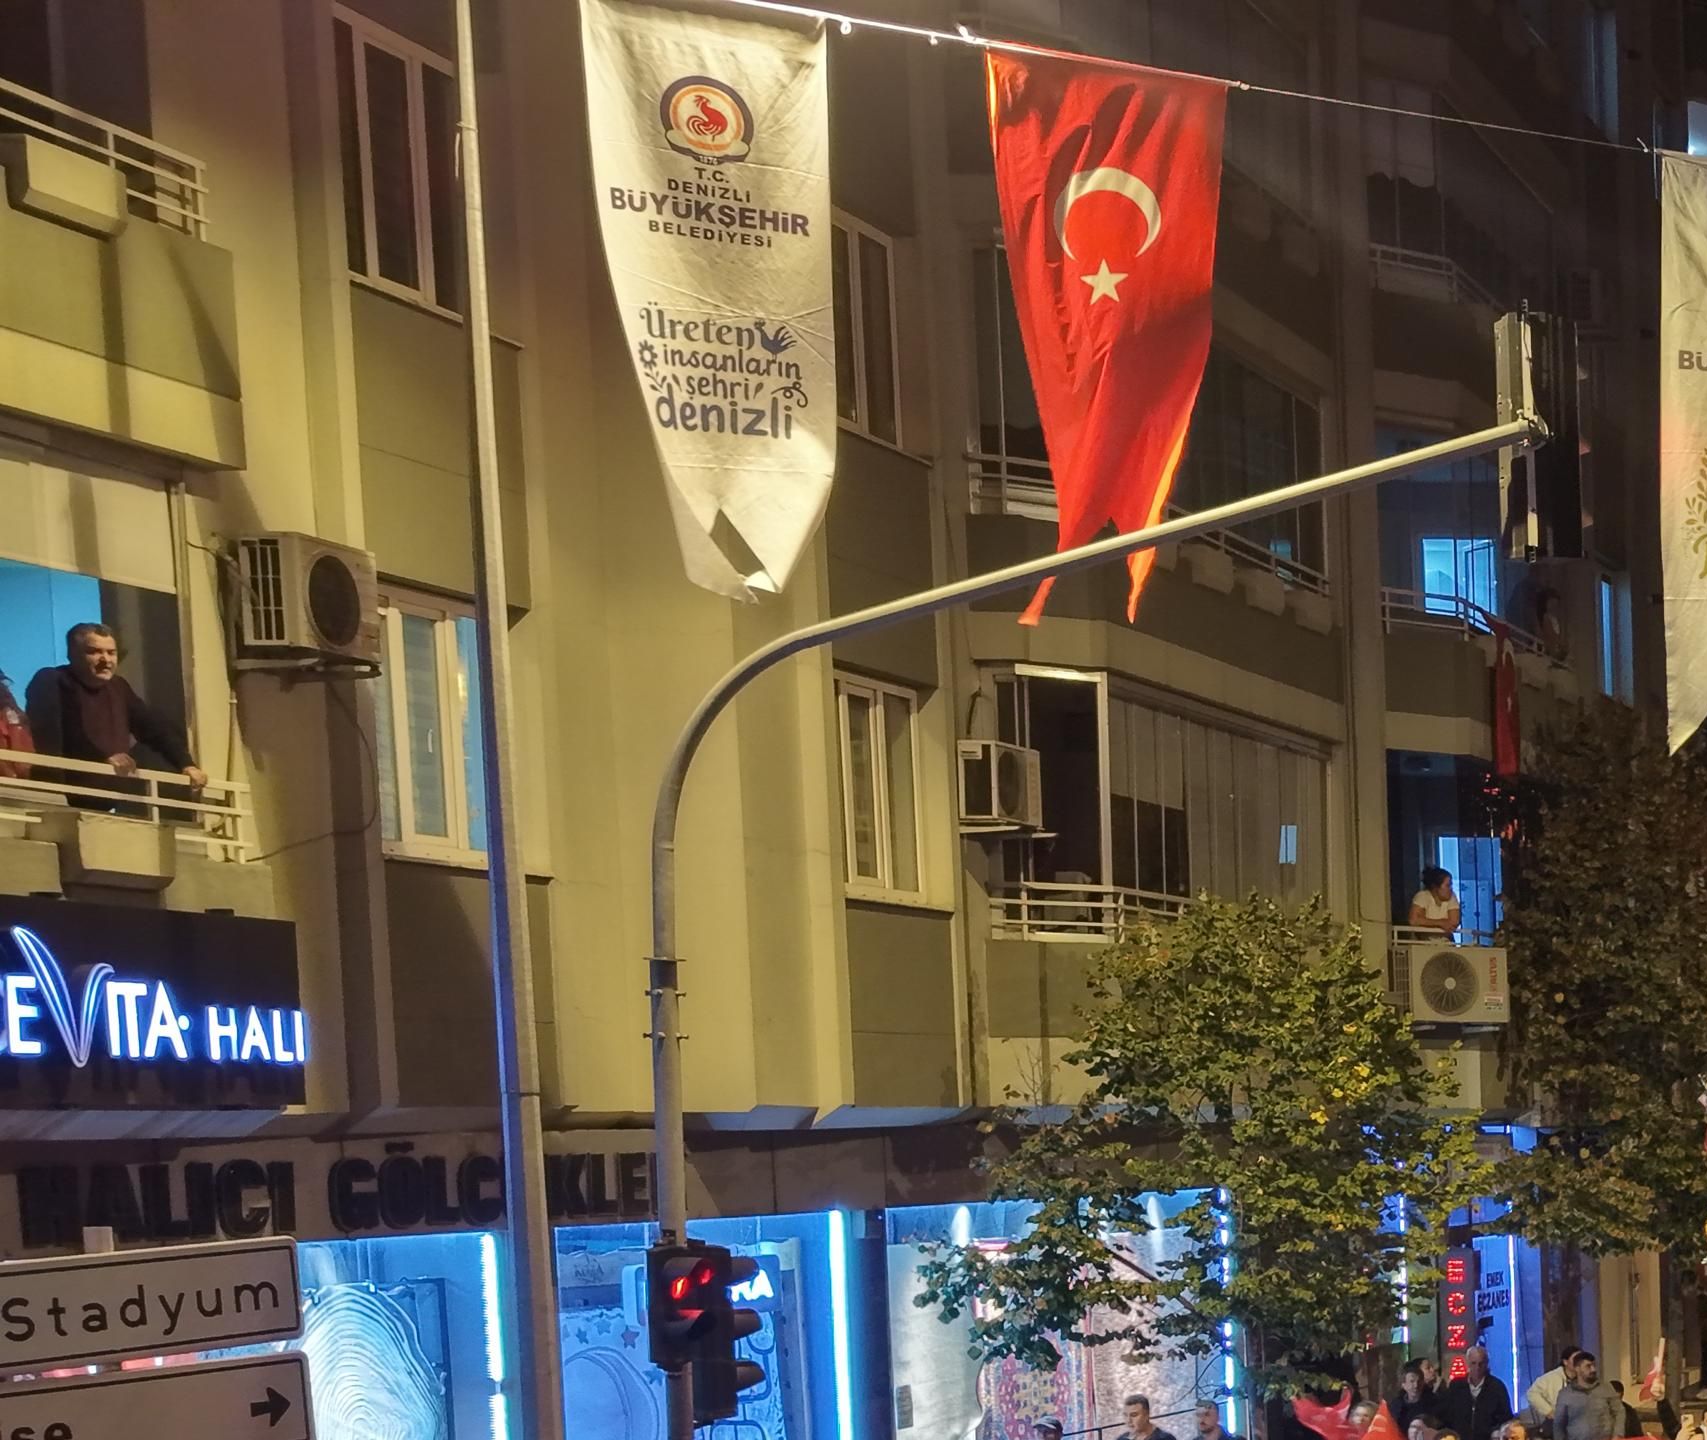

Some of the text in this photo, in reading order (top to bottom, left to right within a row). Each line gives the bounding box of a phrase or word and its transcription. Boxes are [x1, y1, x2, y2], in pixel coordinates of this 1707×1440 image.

[667, 178, 751, 203] DENİZLİ
[694, 166, 730, 184] T.C.
[610, 187, 810, 237] BÜYÜKŞEHİR
[649, 219, 772, 248] BELEDİYESİ
[639, 301, 756, 351] Üreten
[663, 344, 802, 380] insanların
[686, 373, 750, 400] şehri
[656, 382, 793, 440] denizli
[0, 926, 306, 1068] EVITA HALI
[18, 1157, 297, 1248] HALICI
[1, 1280, 280, 1342] Stadyum
